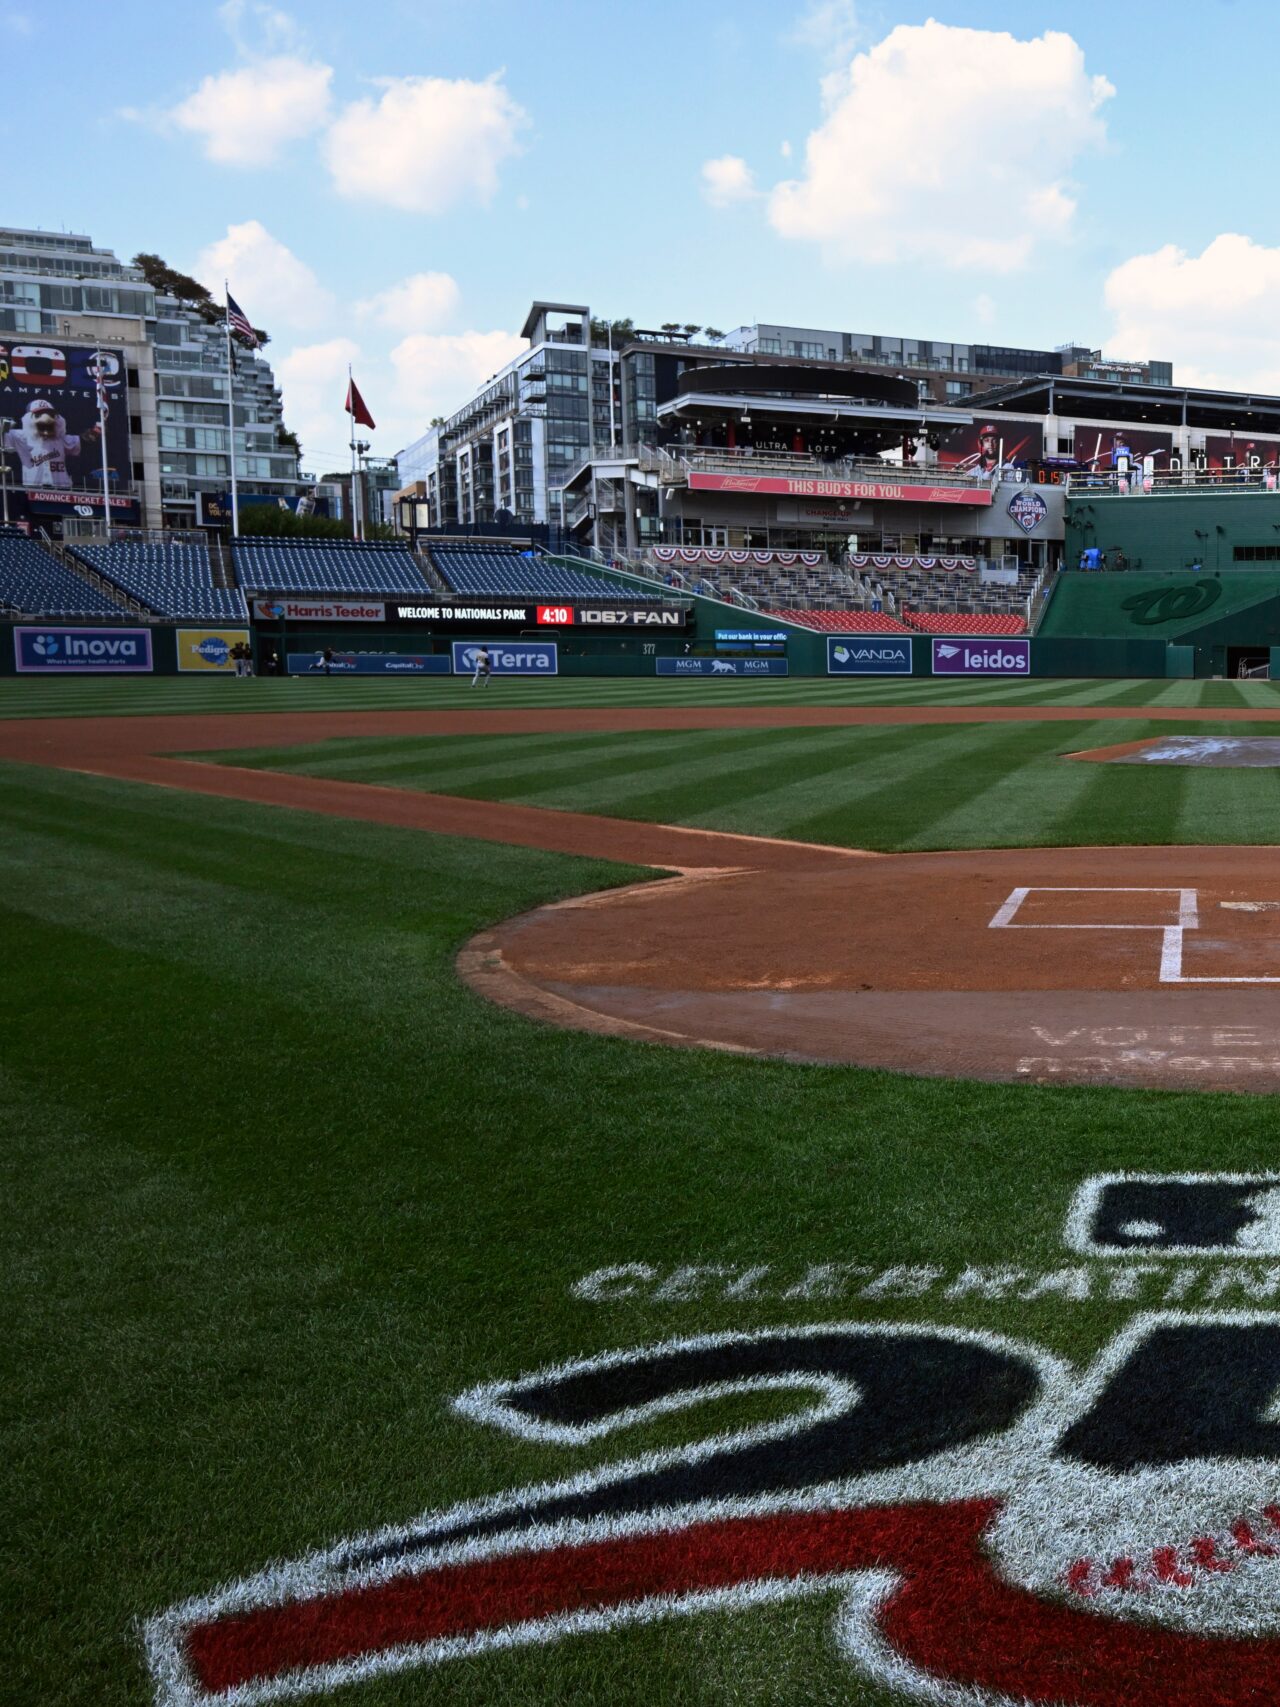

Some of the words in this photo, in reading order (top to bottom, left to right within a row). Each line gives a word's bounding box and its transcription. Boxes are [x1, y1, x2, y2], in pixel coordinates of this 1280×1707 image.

[755, 441, 788, 450] ULTRA
[808, 444, 838, 453] LOFT
[788, 479, 815, 494] THIS
[817, 482, 851, 496] BUD'S
[854, 483, 876, 497] FOR
[878, 485, 904, 498] YOU.
[34, 493, 70, 503] ADVANCE
[73, 495, 100, 505] TICKET
[1010, 506, 1046, 514] CHAMPIONS
[287, 604, 332, 618] Harris
[333, 605, 381, 618] Teeter
[398, 607, 440, 619] WELCOME
[441, 608, 453, 619] TO
[454, 608, 502, 620] NATIONALS
[503, 609, 526, 620] PARK
[542, 607, 568, 622] 4:10
[580, 610, 628, 623] 106.7
[633, 611, 679, 624] FAN
[65, 636, 137, 655] Inova
[191, 643, 231, 656] Pedigre
[642, 643, 656, 655] 377
[491, 651, 549, 668] Terra
[850, 649, 906, 660] VANDA
[964, 648, 1026, 668] leidos
[676, 660, 702, 668] MGM
[1029, 1025, 1262, 1047] VOTE
